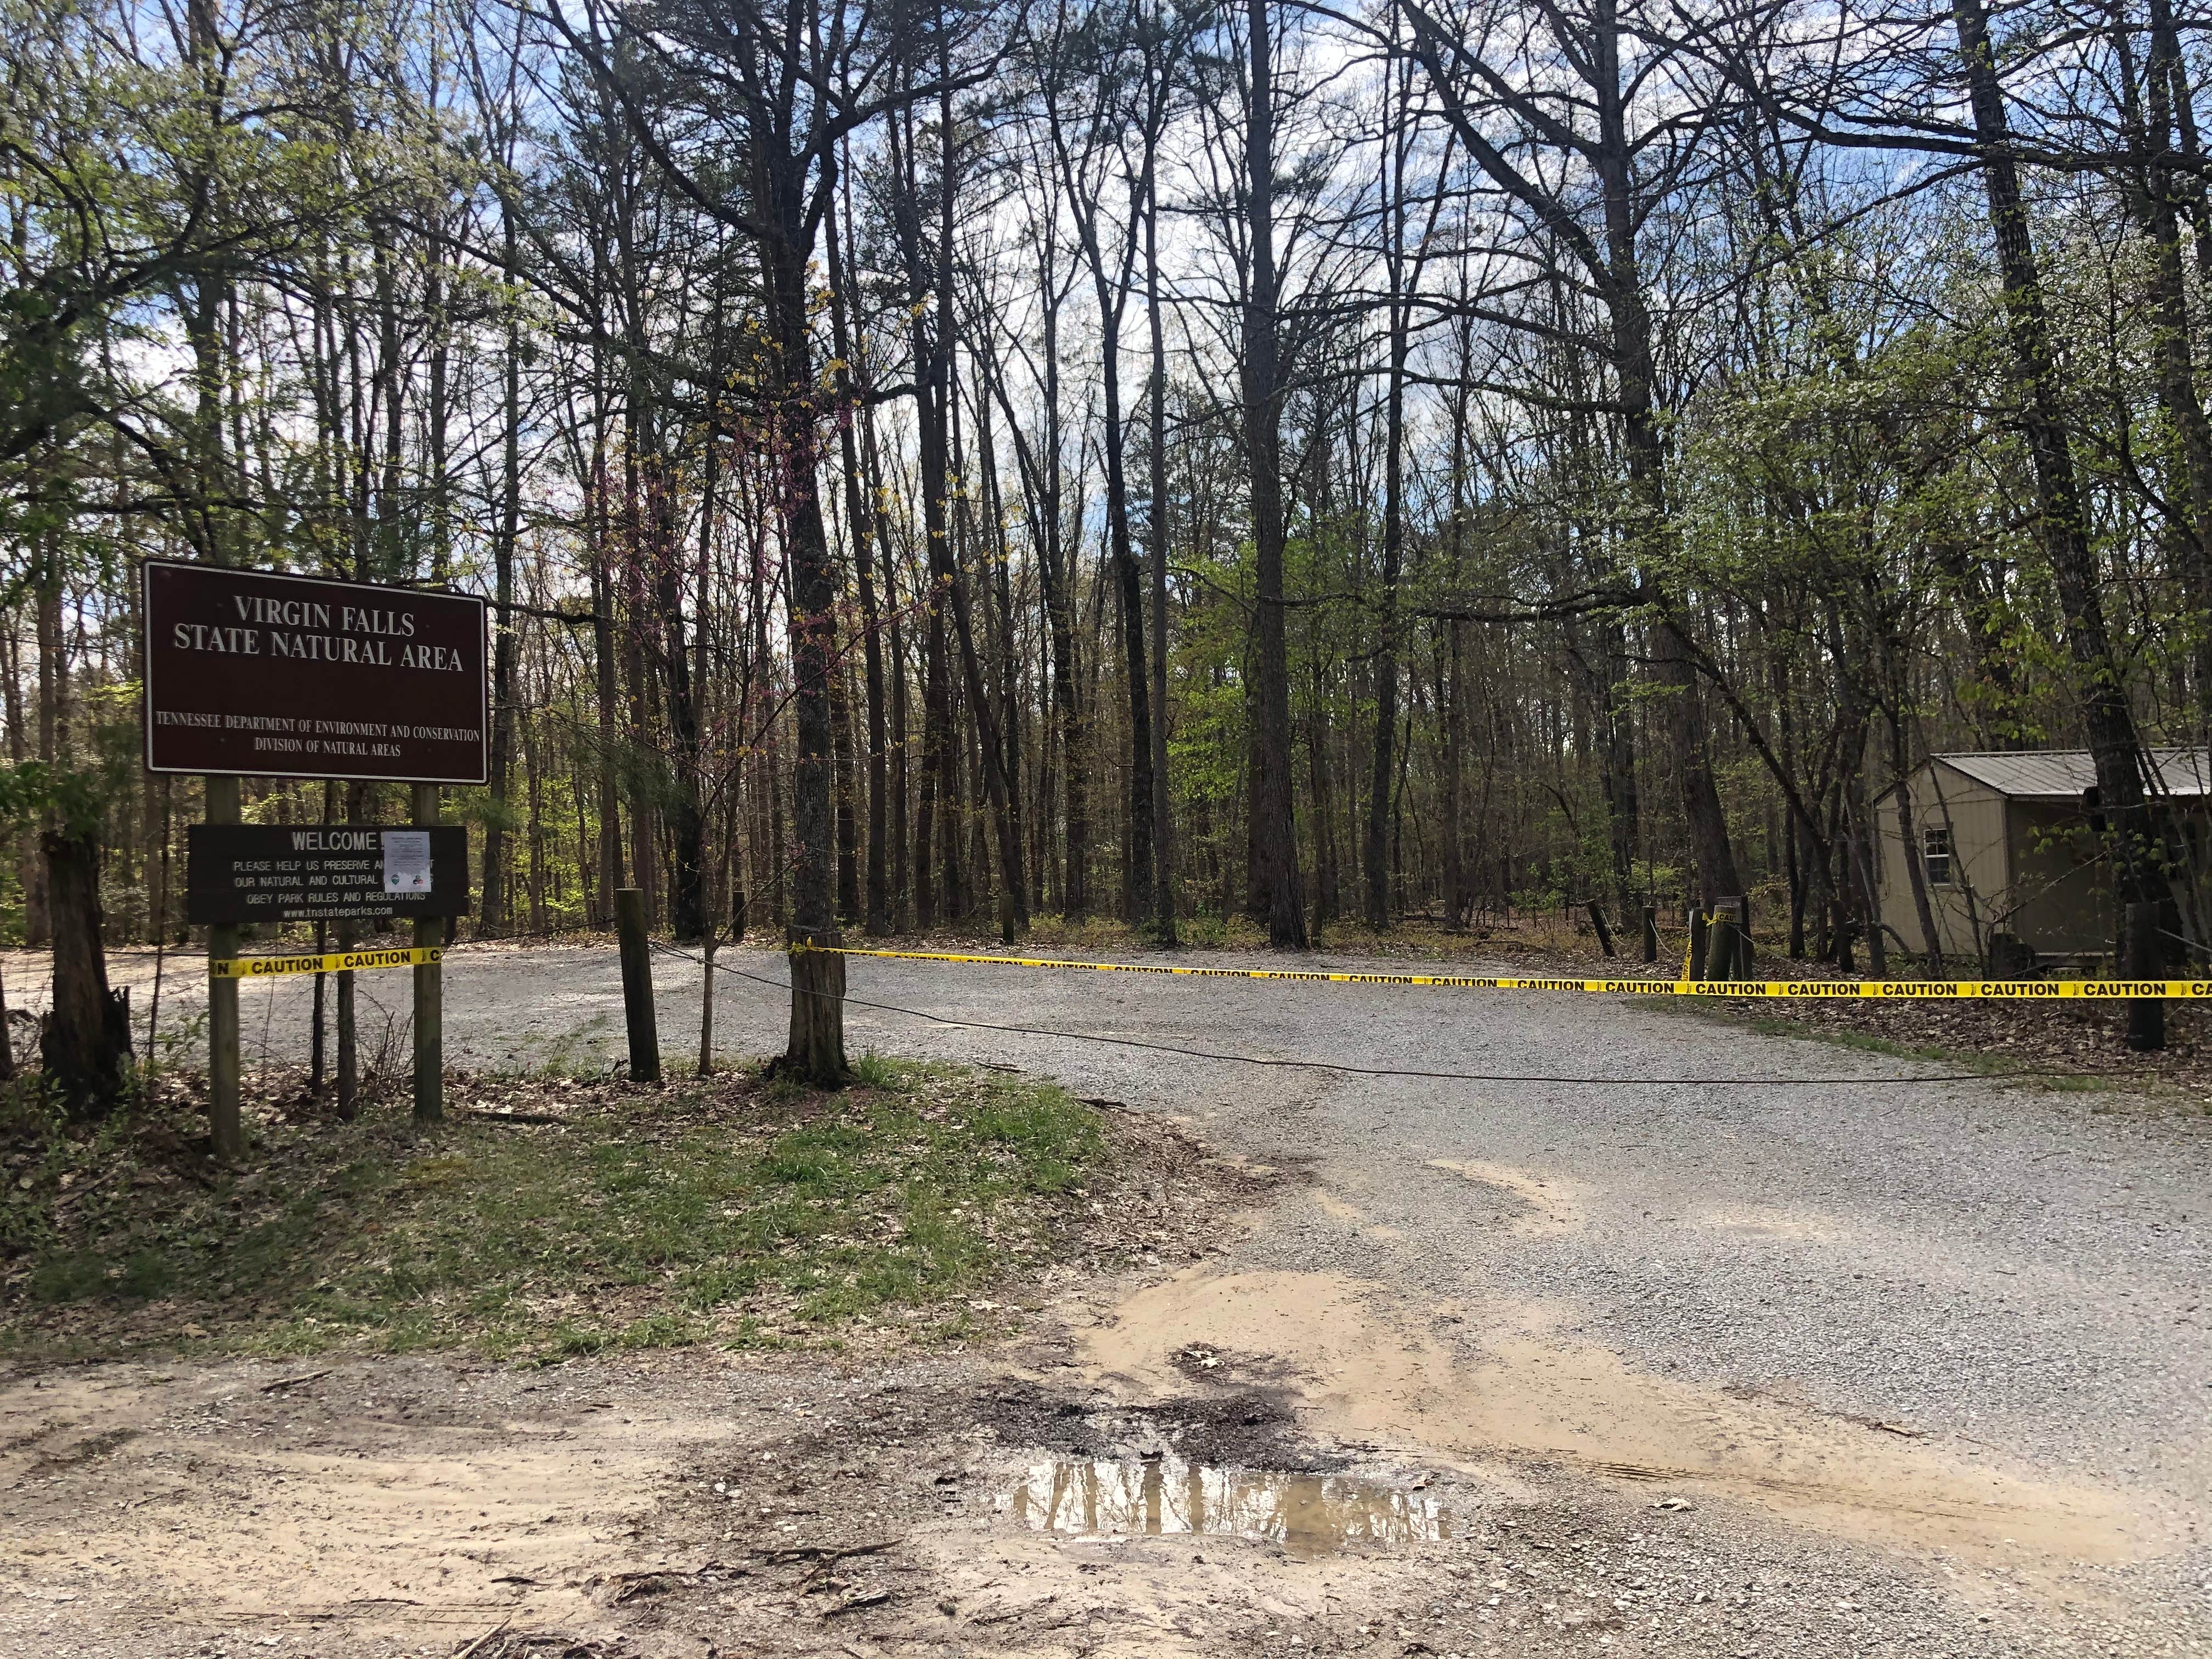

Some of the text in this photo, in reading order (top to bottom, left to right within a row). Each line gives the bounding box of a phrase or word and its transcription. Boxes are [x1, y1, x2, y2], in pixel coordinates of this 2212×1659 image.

[233, 595, 415, 637] VIRGIN FALLS
[174, 623, 464, 672] STATE NATURAL AREA
[156, 711, 480, 742] TENNESSEE DEPARTMENT OF ENVIRONMENT AND CONSERVATION
[255, 737, 401, 757] DIVISION OF NATURAL AREAS
[234, 859, 383, 871] PLEASE HELP US PRESERVE AN
[235, 874, 379, 888] OUR NATURAL AND CULTURAL
[247, 891, 426, 904] OBEY PARK RULES AND REGULATIONS
[283, 906, 393, 918] www.tnstateparks.com
[251, 958, 324, 974] CAUTION
[344, 951, 411, 966] CAUTION
[1349, 975, 1413, 984] CAUTION
[1432, 978, 1497, 987] CAUTION
[1517, 980, 1585, 991] CAUTION
[1605, 981, 1674, 994] CAUTION
[1695, 983, 1766, 995] CAUTION
[1788, 984, 1860, 995] CAUTION
[1882, 984, 1957, 996] CAUTION
[1981, 984, 2059, 996] CAUTION
[2084, 983, 2166, 996] CAUTION
